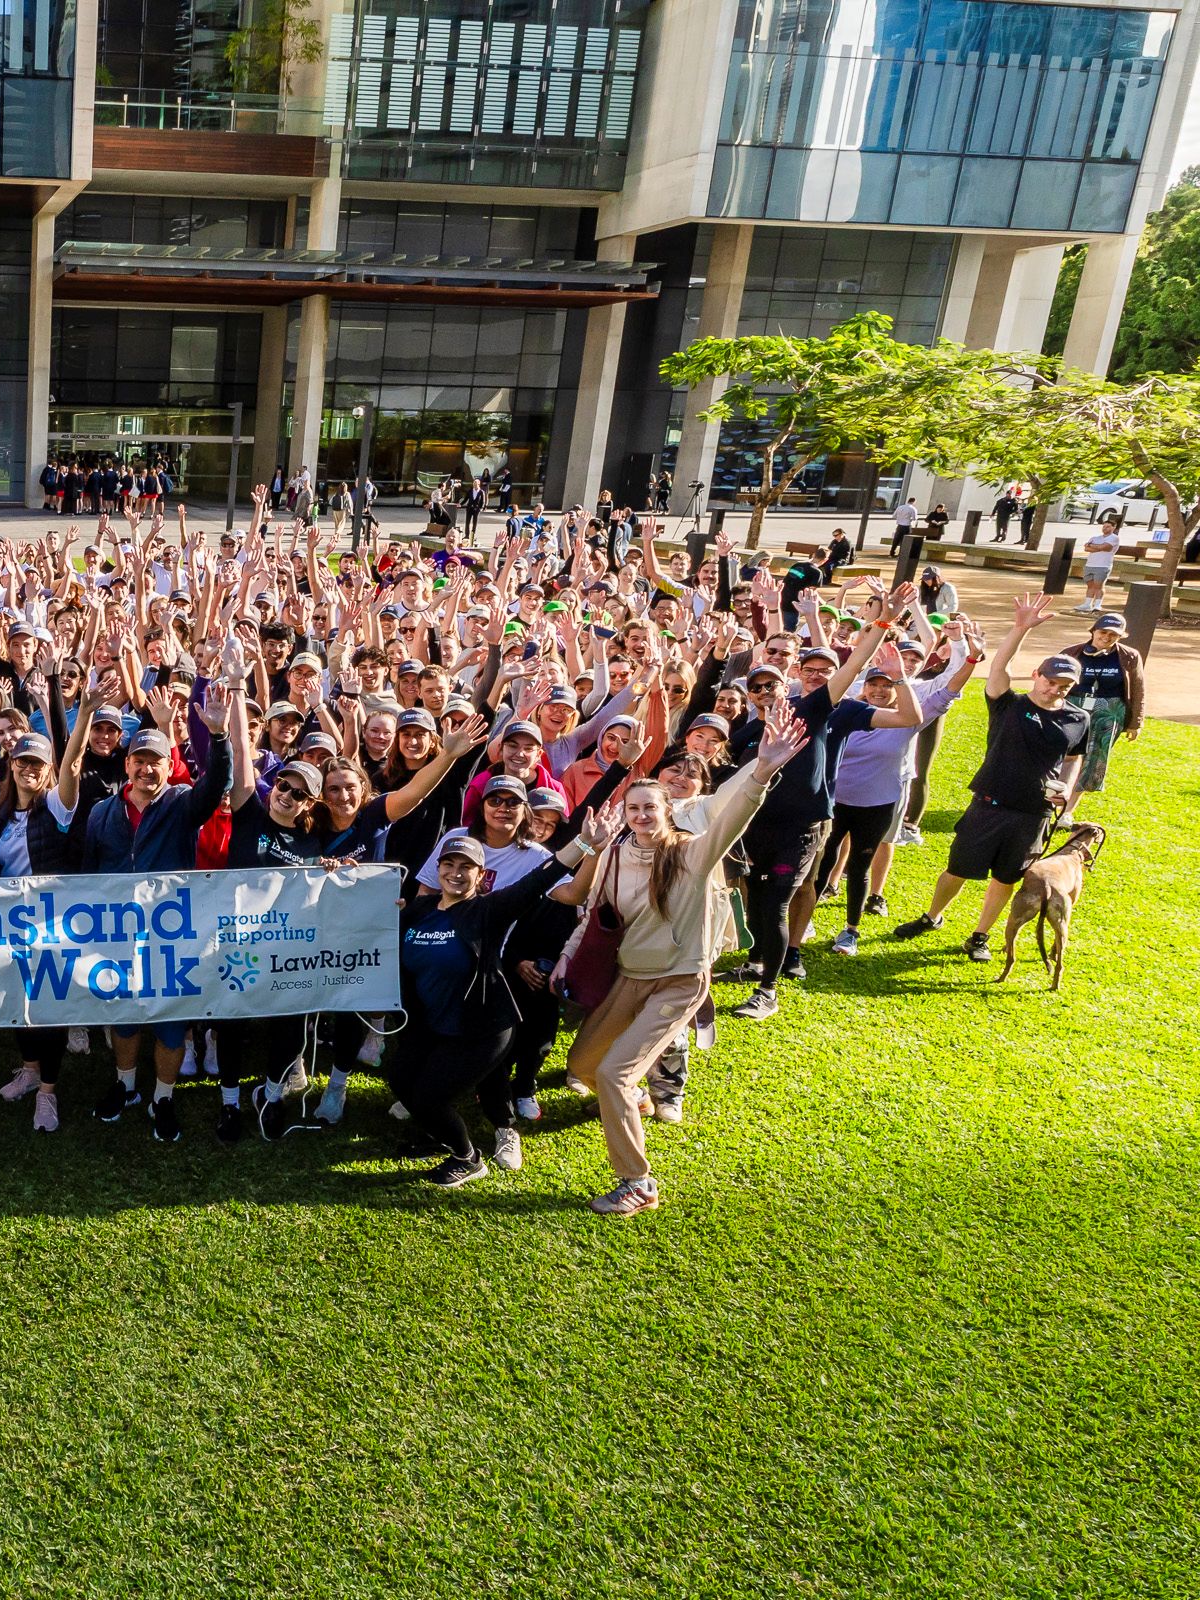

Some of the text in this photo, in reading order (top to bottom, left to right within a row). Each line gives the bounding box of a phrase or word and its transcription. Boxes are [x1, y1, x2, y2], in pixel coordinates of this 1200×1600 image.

[271, 841, 304, 864] LawRight
[218, 910, 290, 929] proudly
[218, 926, 317, 946] supporting
[415, 929, 455, 940] LawRight
[269, 948, 382, 974] LawRight
[11, 944, 202, 1001] Walk
[270, 974, 365, 992] Access Justice
